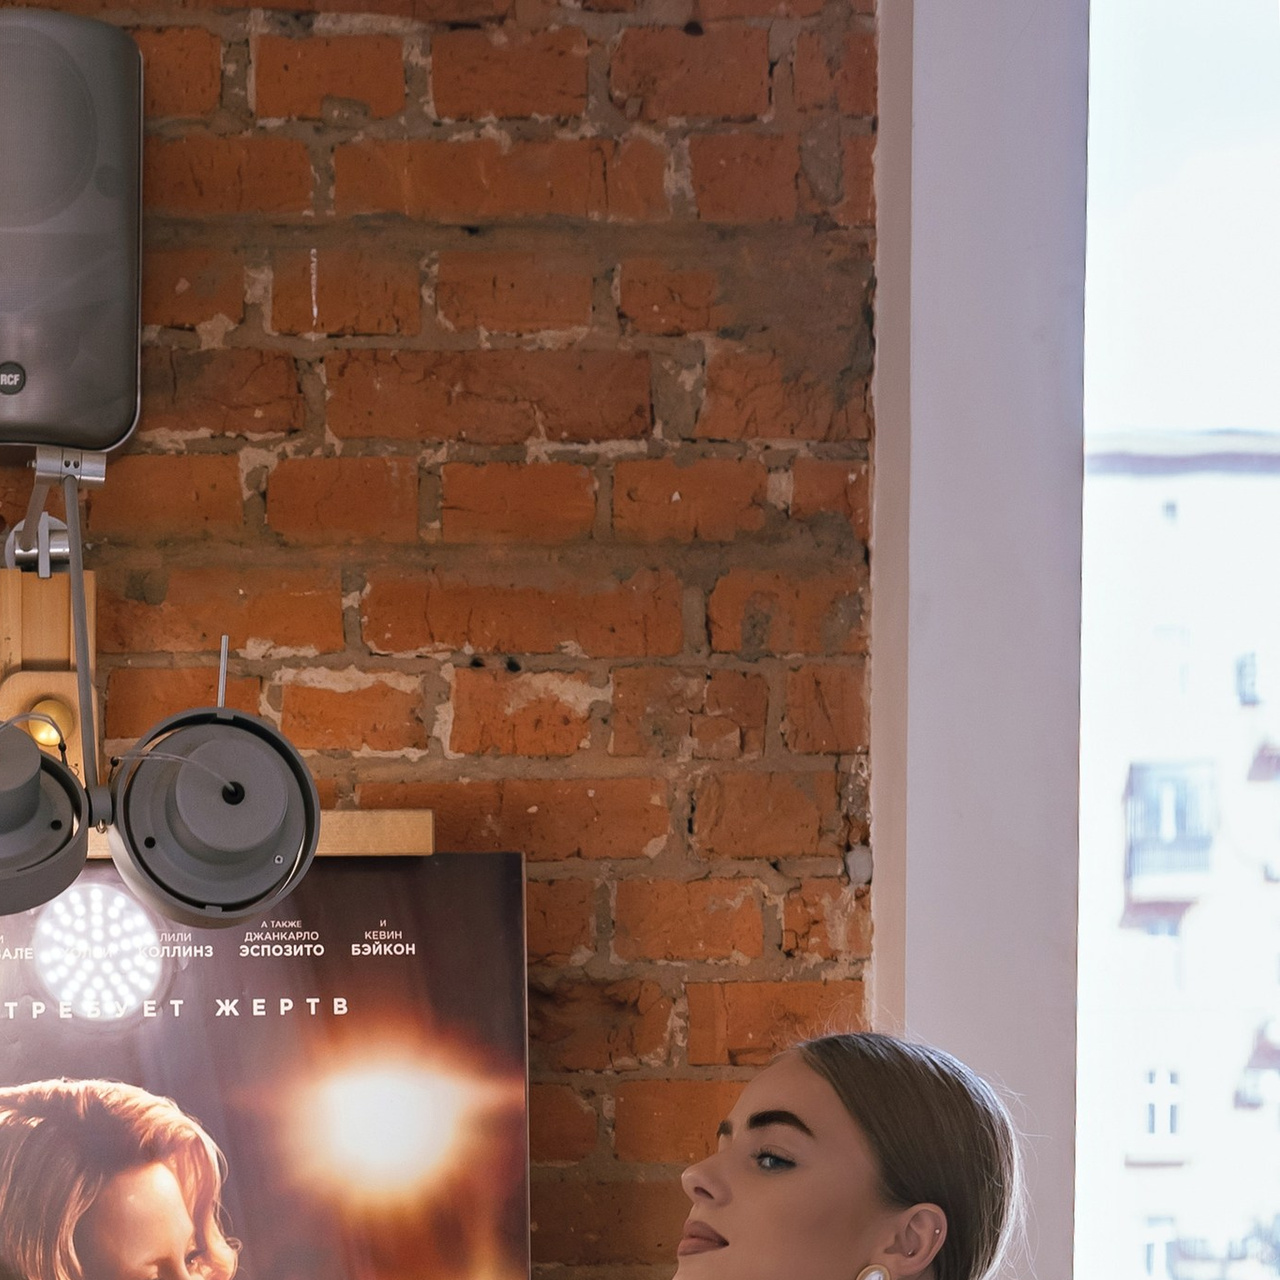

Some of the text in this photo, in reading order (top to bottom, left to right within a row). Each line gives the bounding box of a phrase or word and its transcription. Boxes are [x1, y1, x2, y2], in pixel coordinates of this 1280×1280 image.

[0, 373, 20, 385] RCF
[261, 920, 302, 929] А ТАКЖЕ
[159, 933, 192, 942] ЛИЛИ
[244, 931, 319, 942] ДЖАНКАРЛО
[364, 930, 403, 940] КЕВИН
[138, 945, 214, 958] КОЛЛИНЗ
[239, 944, 325, 957] ЭСПОЗИТО
[351, 941, 416, 955] БЭЙКОН
[4, 1000, 184, 1019] ТРЕБУЕТ
[215, 998, 348, 1016] ЖЕРТВ
